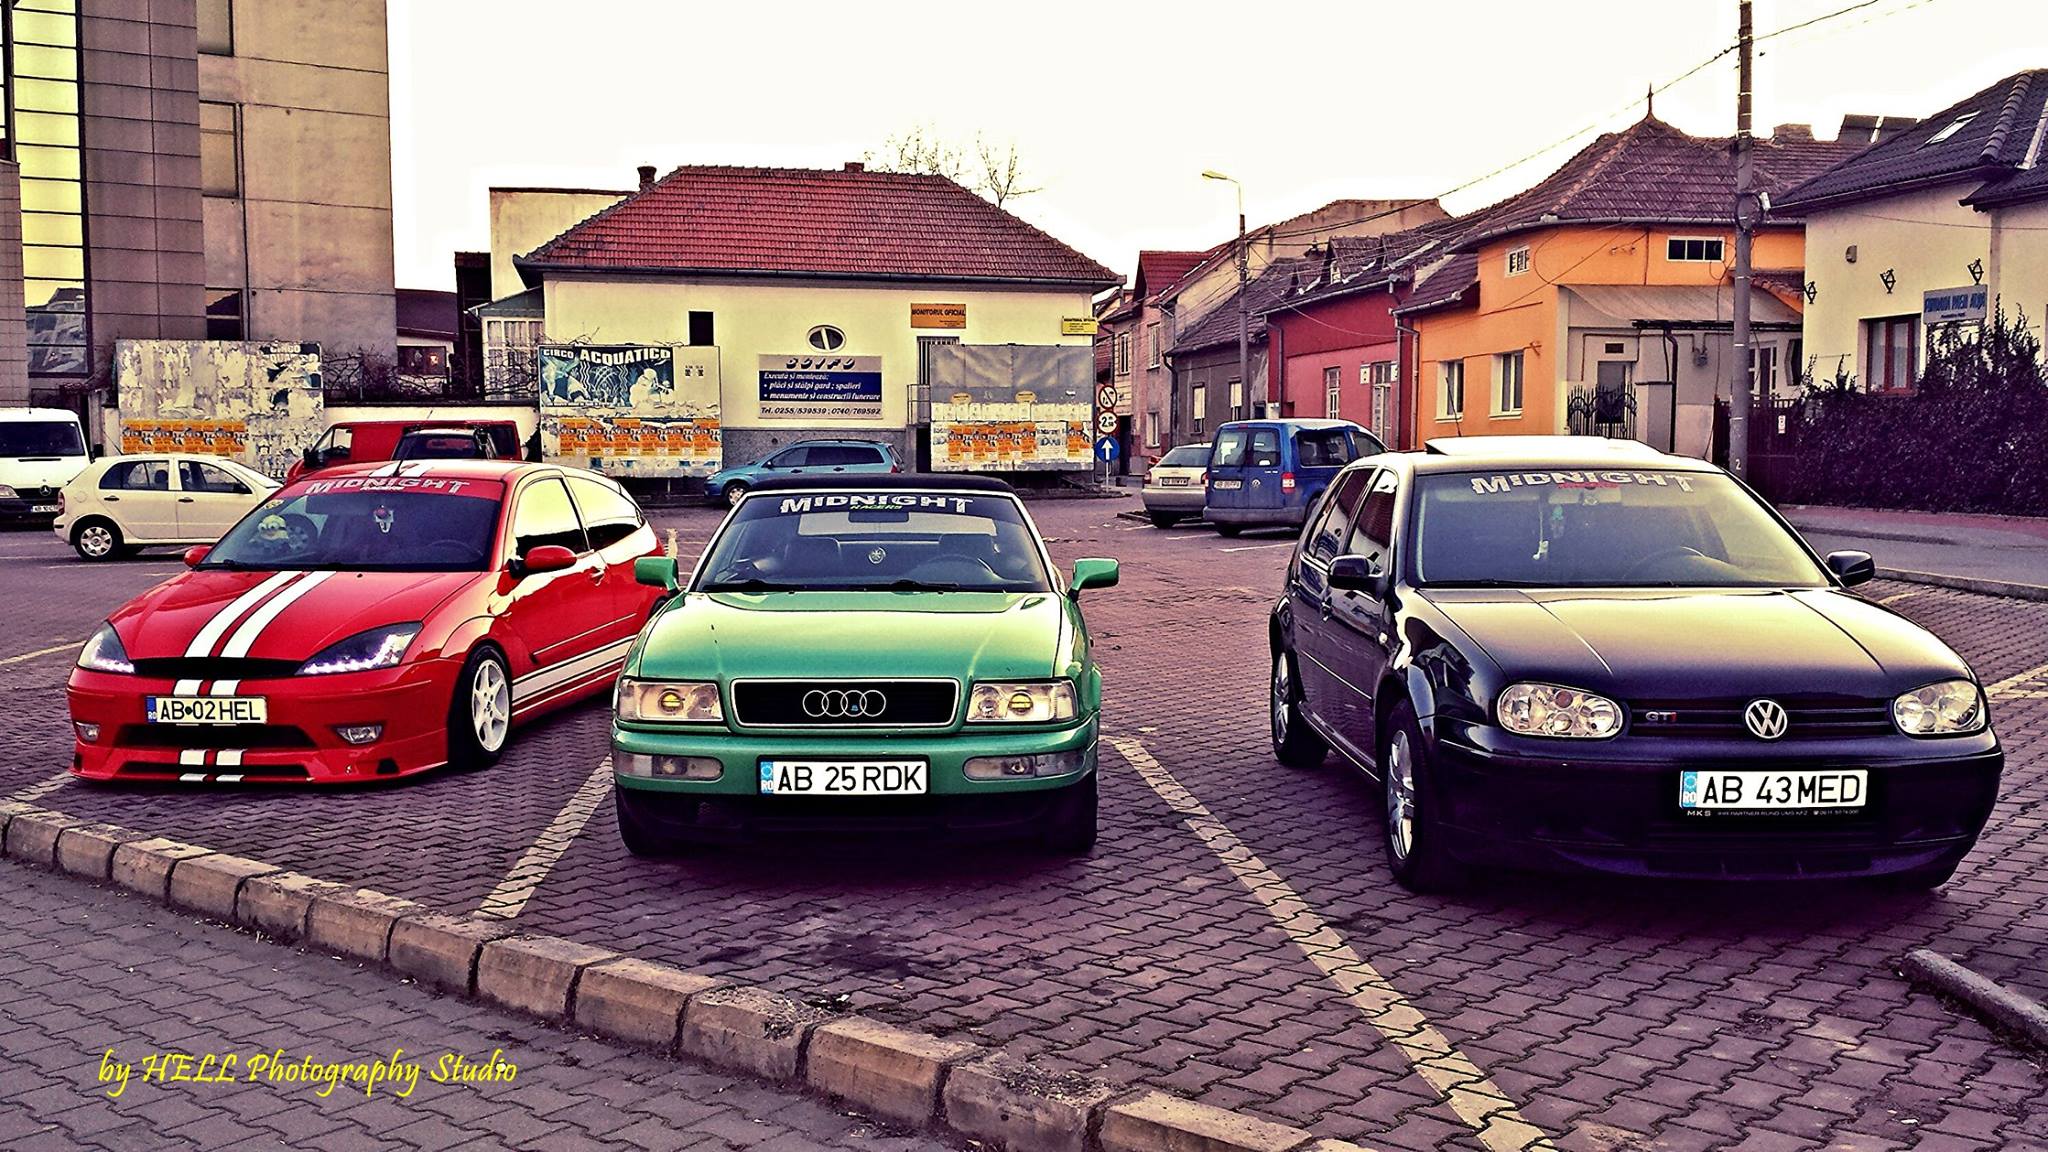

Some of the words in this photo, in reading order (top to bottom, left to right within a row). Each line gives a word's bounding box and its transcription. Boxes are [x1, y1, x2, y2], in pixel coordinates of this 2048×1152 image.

[911, 308, 943, 316] MONITORUL
[543, 349, 574, 359] CIRCO
[580, 348, 671, 367] ACQUATICO
[814, 382, 831, 391] gard
[1735, 458, 1742, 471] 2
[305, 477, 470, 495] MIDNIGHT
[1471, 472, 1695, 494] MIDNIGHT
[779, 495, 974, 514] MIDNIGHT
[160, 700, 185, 720] AB
[1645, 711, 1677, 722] GTI
[778, 766, 813, 791] AB
[1703, 776, 1743, 804] AB
